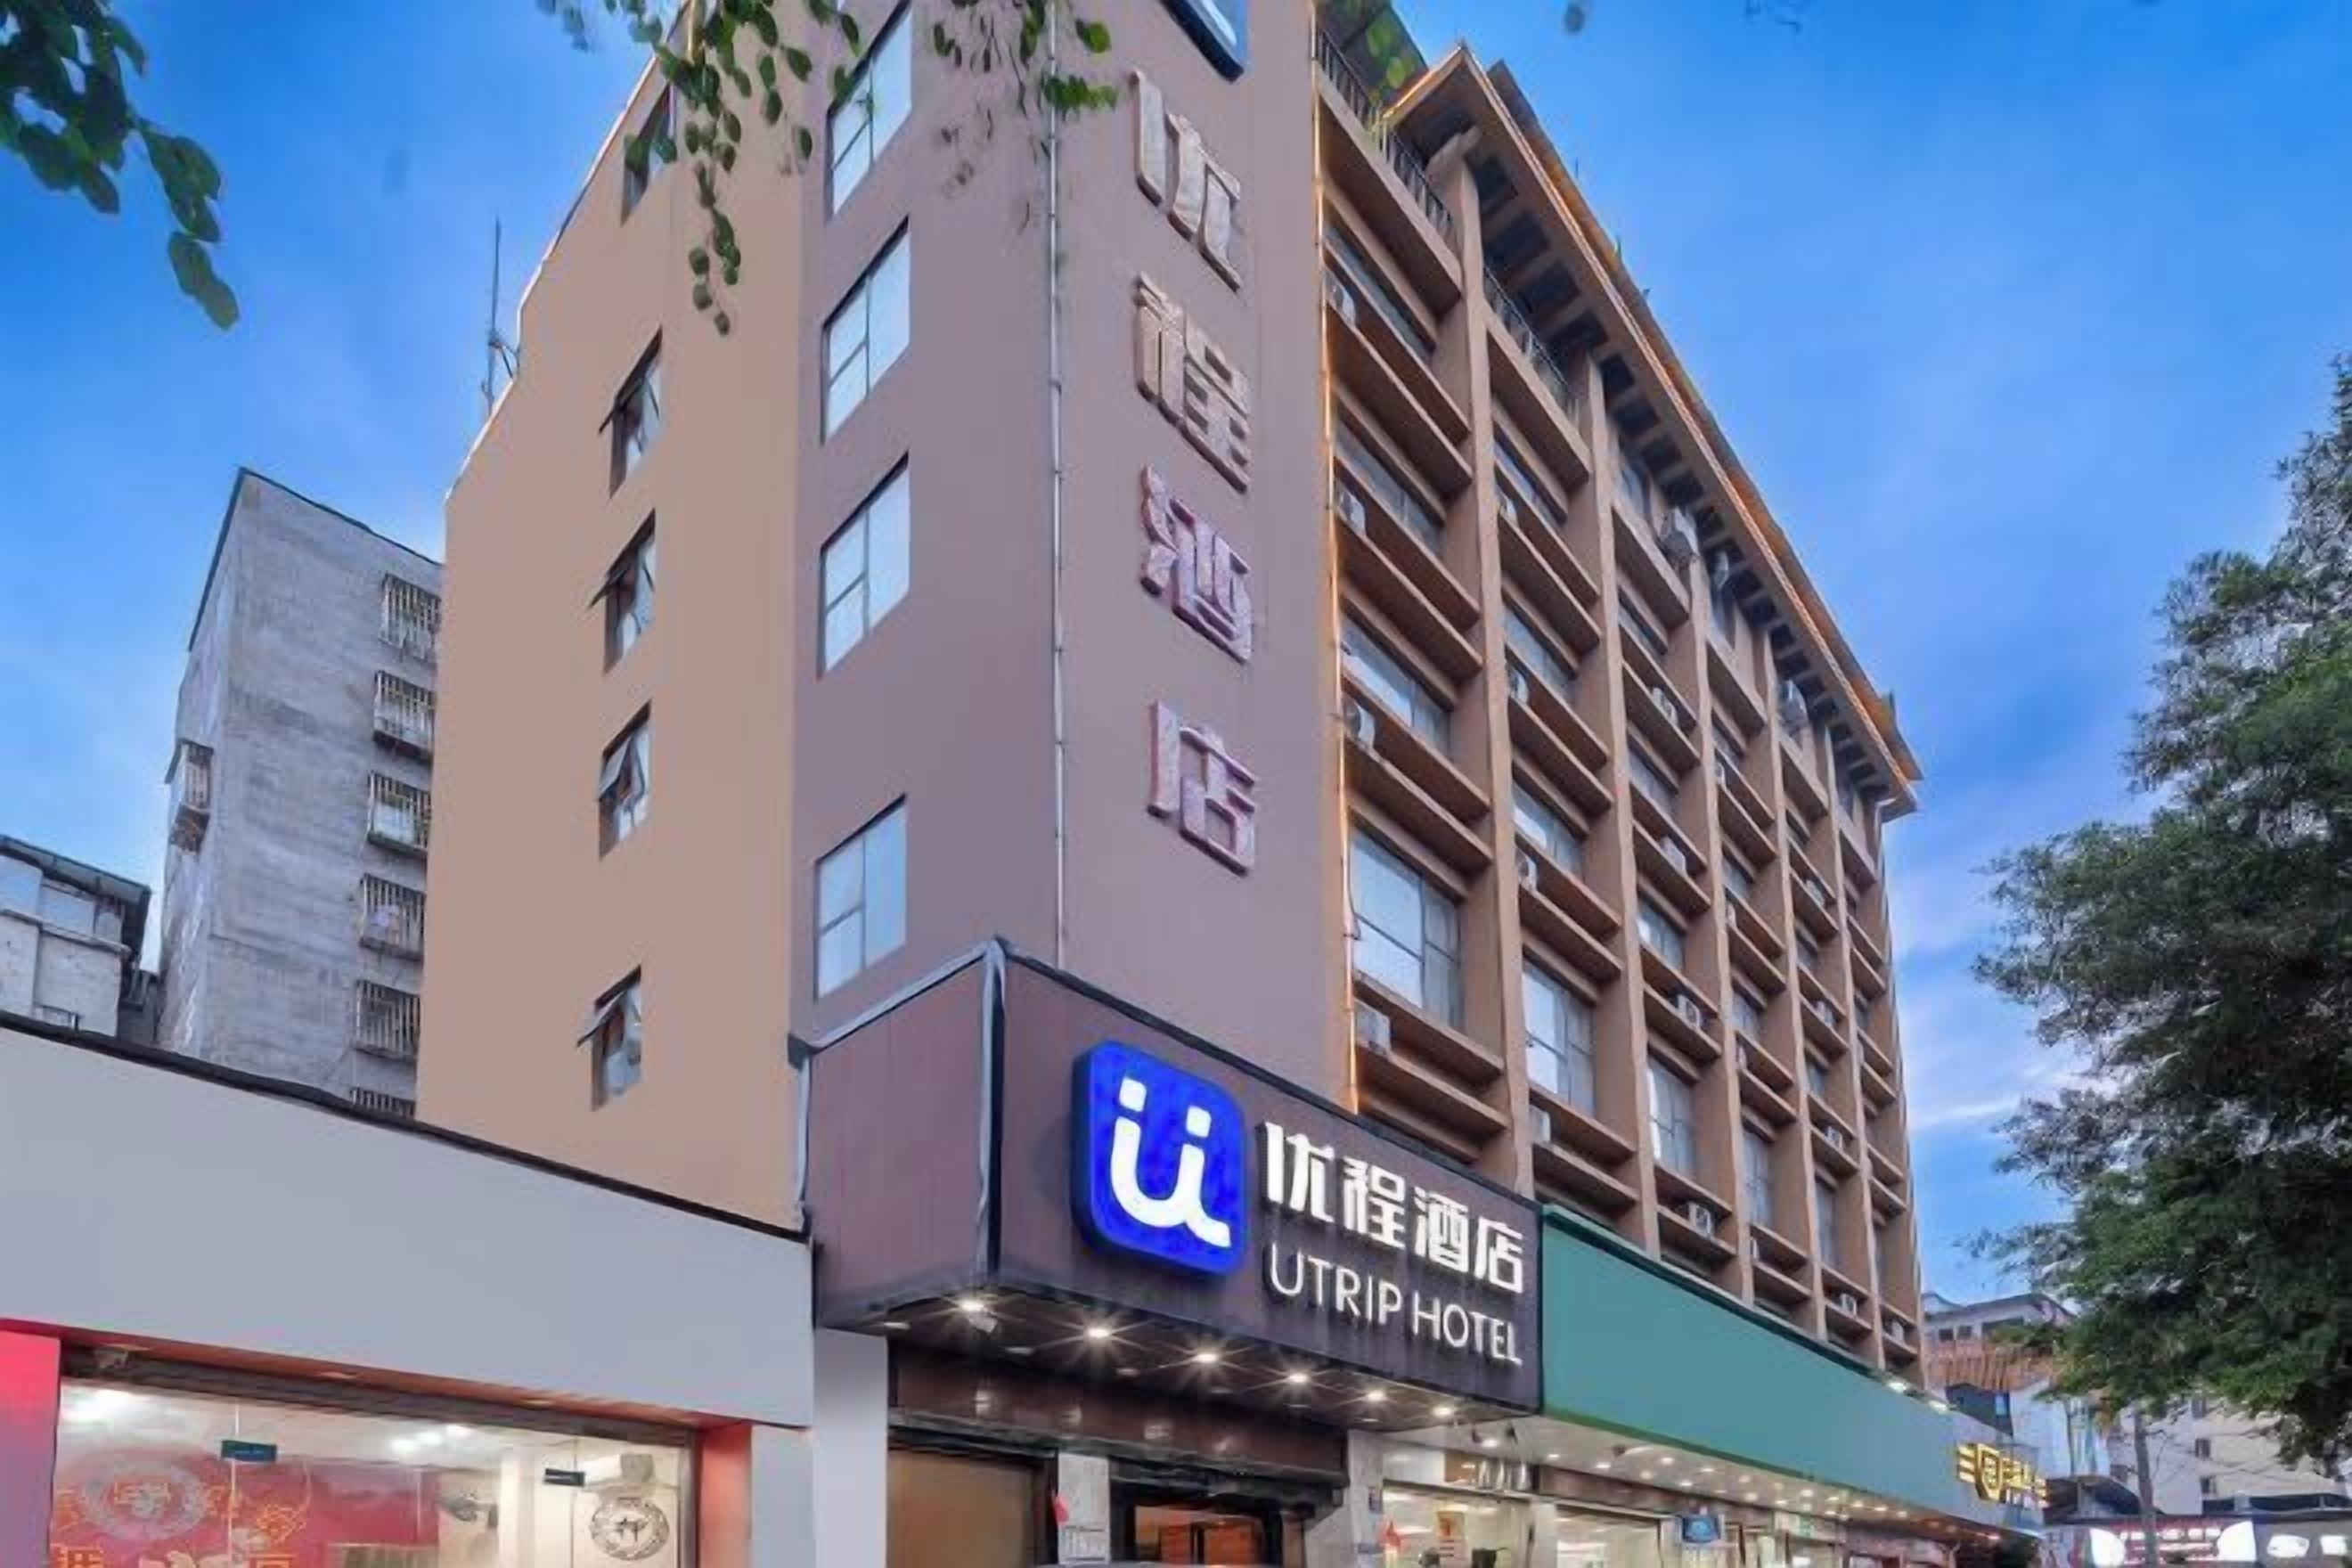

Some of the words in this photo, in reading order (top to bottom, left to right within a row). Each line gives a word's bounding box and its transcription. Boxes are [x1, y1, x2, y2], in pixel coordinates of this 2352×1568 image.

[1263, 1121, 1523, 1294] 优程酒店
[1270, 1242, 1402, 1326] UTRIP
[1412, 1291, 1523, 1366] HOTEL
